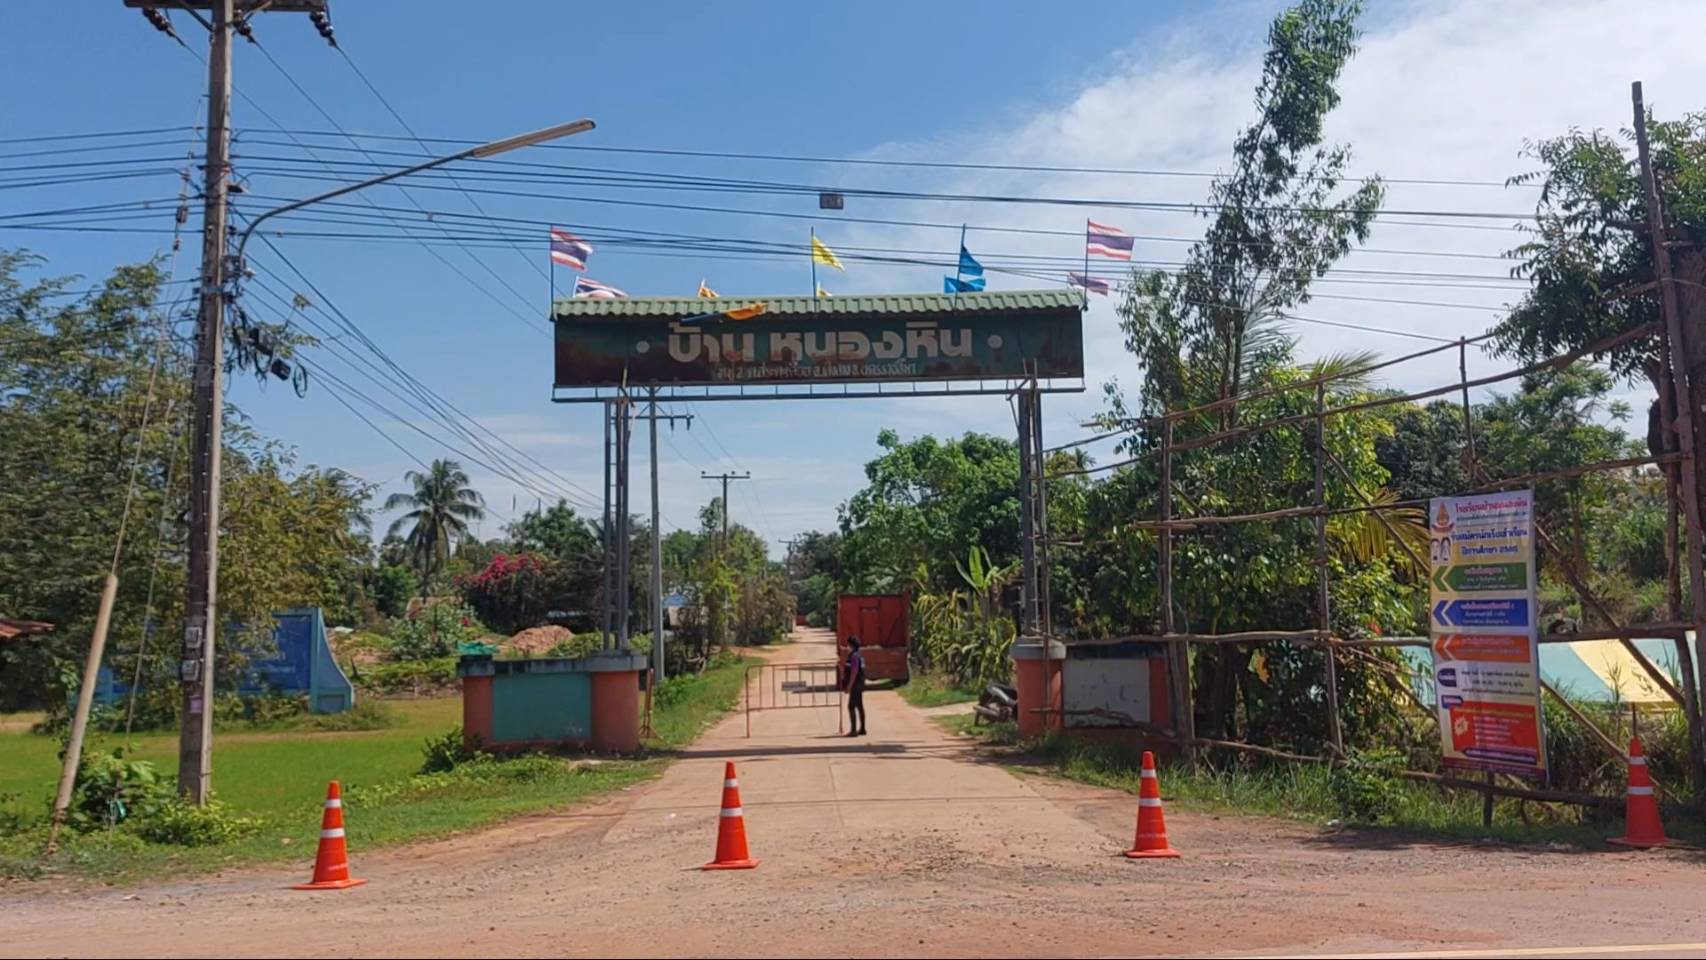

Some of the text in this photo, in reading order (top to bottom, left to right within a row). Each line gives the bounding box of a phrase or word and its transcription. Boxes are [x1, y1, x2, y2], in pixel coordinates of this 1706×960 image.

[667, 321, 972, 362] บ้าน หนองหิน
